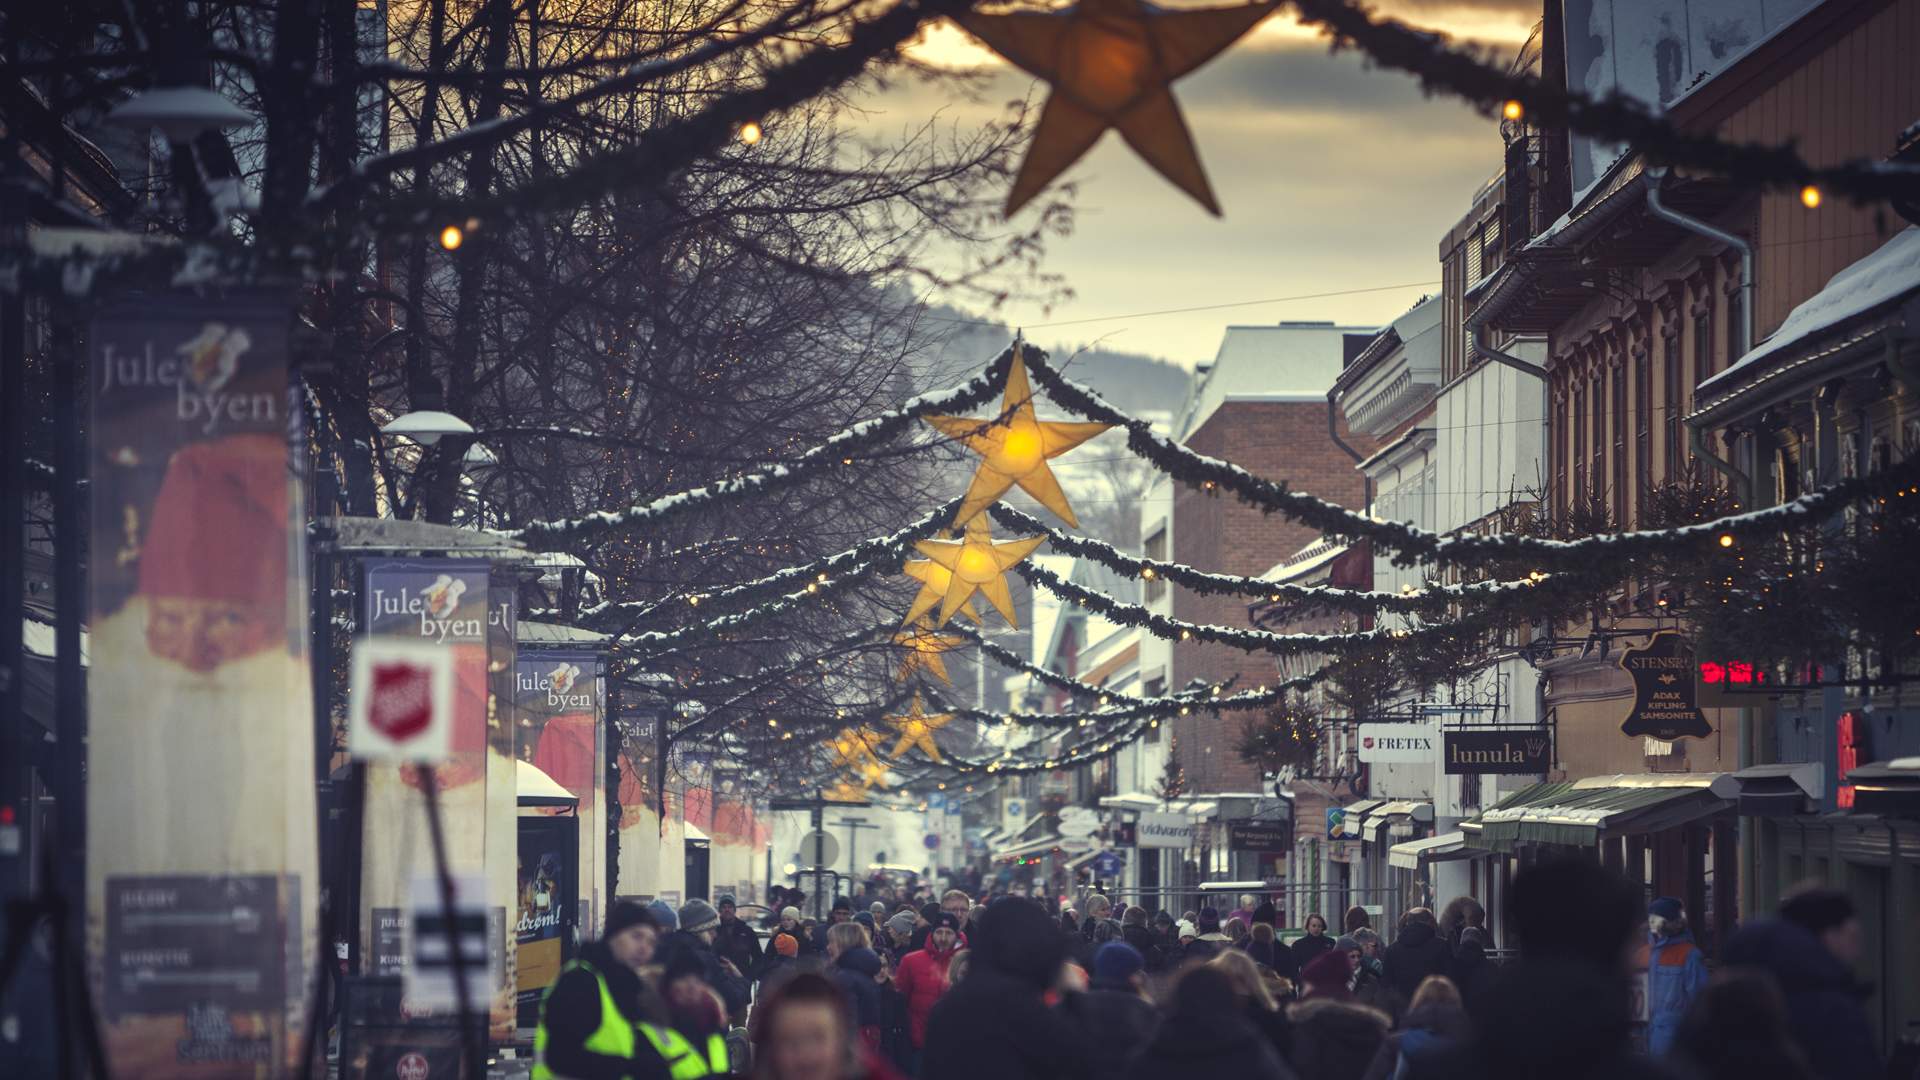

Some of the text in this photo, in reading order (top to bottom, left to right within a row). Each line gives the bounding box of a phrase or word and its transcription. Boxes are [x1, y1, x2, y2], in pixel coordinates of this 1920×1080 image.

[101, 341, 178, 392] Jule
[177, 379, 275, 434] byen
[373, 587, 422, 621] Jule
[421, 609, 483, 645] byen
[516, 671, 549, 693] Jule
[547, 687, 591, 712] byen
[1647, 702, 1687, 710] KIPLING
[1653, 691, 1681, 700] ADAX
[1640, 711, 1697, 720] SAMSONITE
[1378, 737, 1432, 751] FRETEX
[1450, 742, 1525, 764] lunula
[515, 903, 562, 932] drøm!
